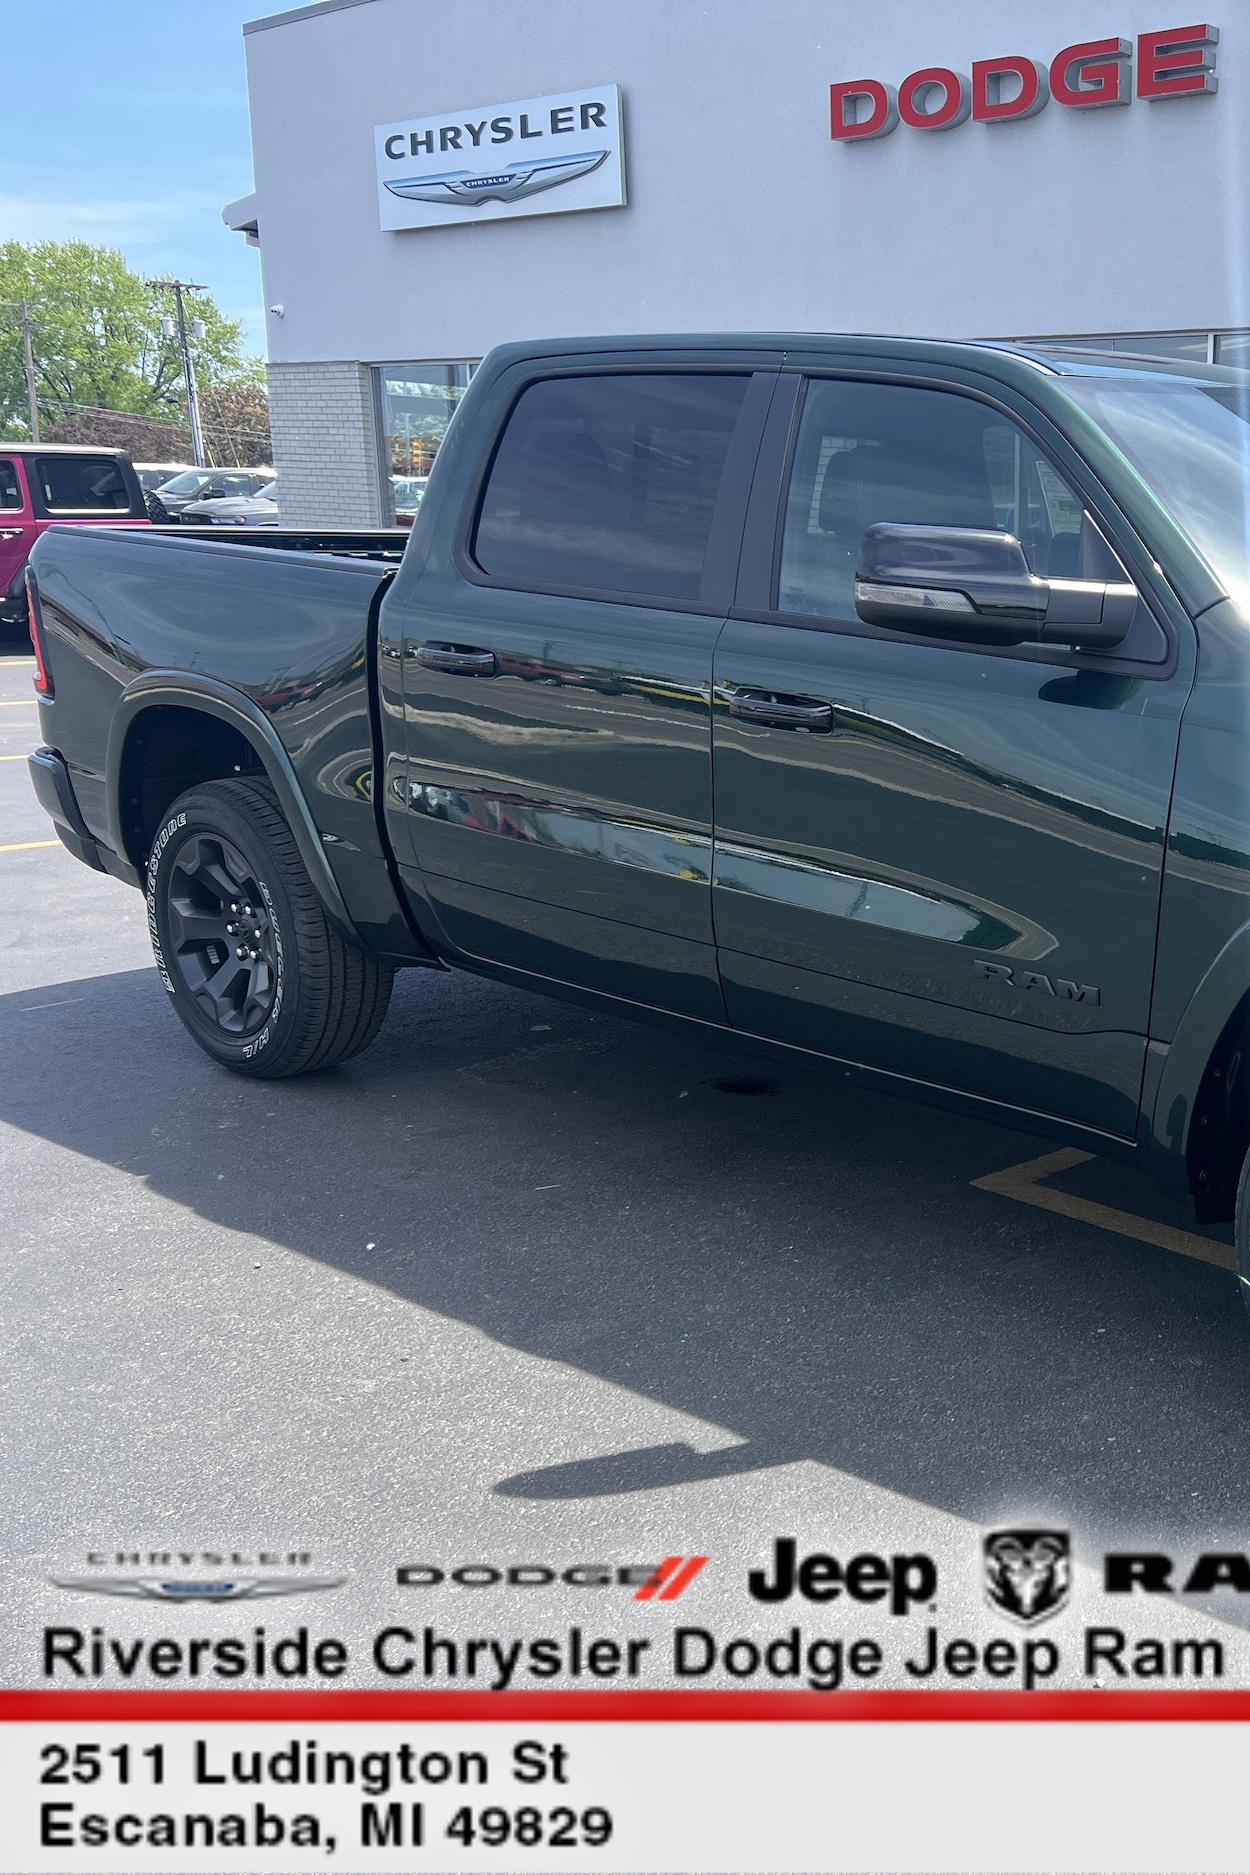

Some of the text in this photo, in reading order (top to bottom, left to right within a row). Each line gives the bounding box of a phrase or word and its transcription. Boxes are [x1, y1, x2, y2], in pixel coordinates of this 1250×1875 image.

[828, 23, 1219, 142] DODGE
[384, 102, 607, 160] CHRYSLER
[466, 176, 510, 187] CHRYSLER
[147, 812, 187, 993] BRIDGESTONE
[242, 881, 285, 1058] DUELER H/L
[973, 958, 1101, 1007] RAM
